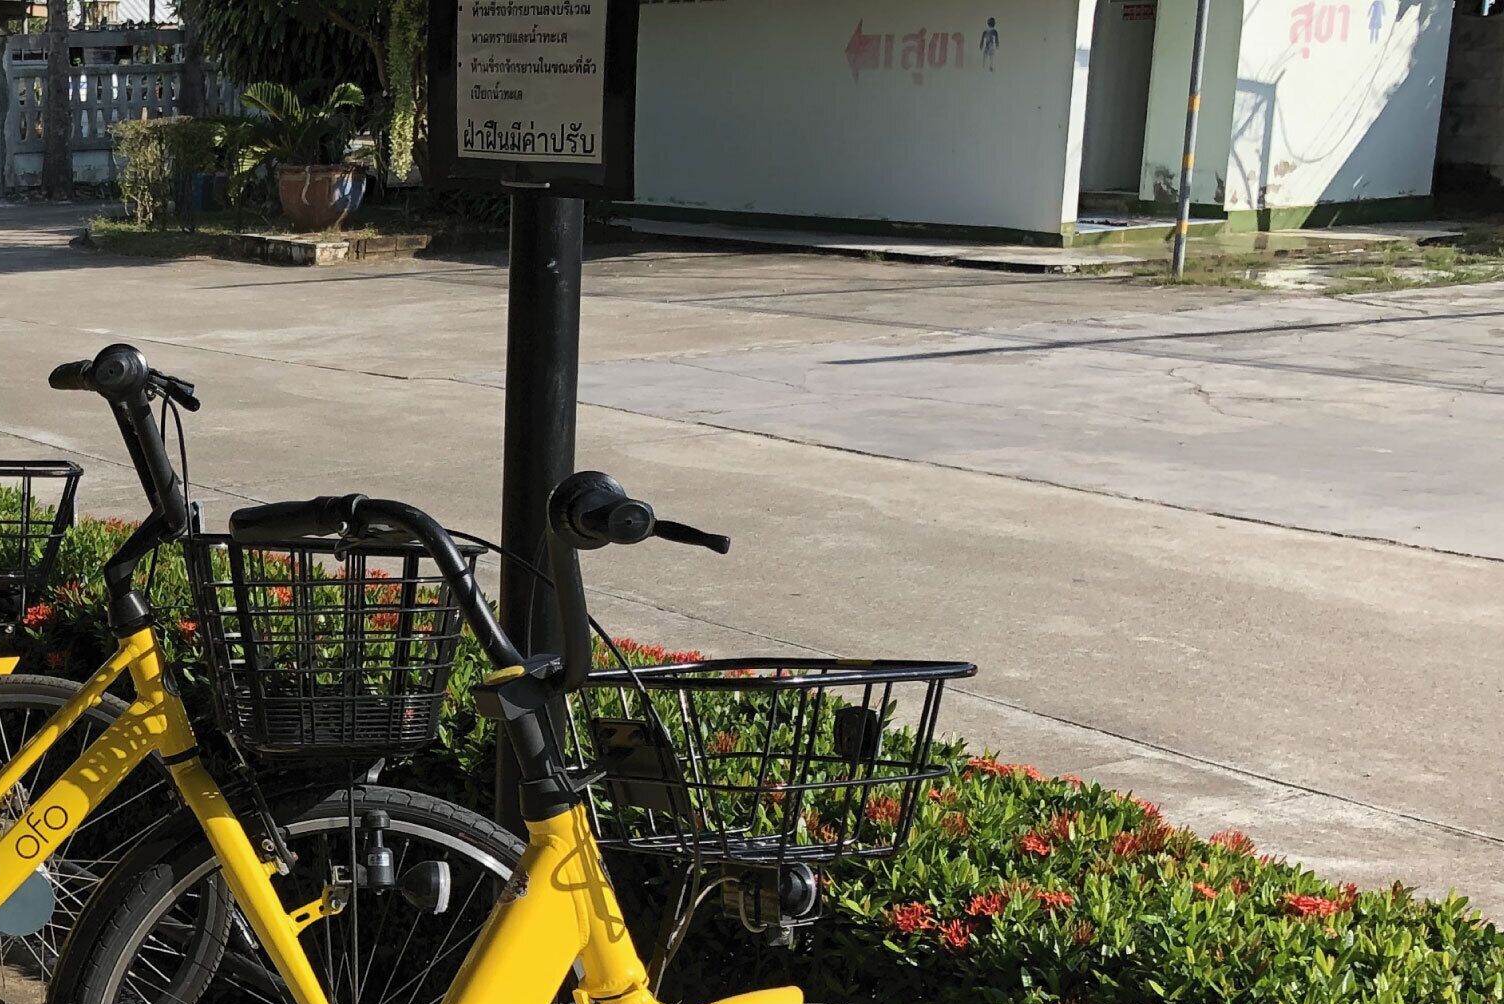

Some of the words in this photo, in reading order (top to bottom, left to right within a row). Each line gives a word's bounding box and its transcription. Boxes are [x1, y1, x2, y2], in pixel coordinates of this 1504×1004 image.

[900, 28, 964, 86] สุขา
[1287, 1, 1351, 60] สุขา
[463, 117, 595, 154] ฝ่าฝืนมีค่าปรับ
[15, 805, 69, 860] ofo
